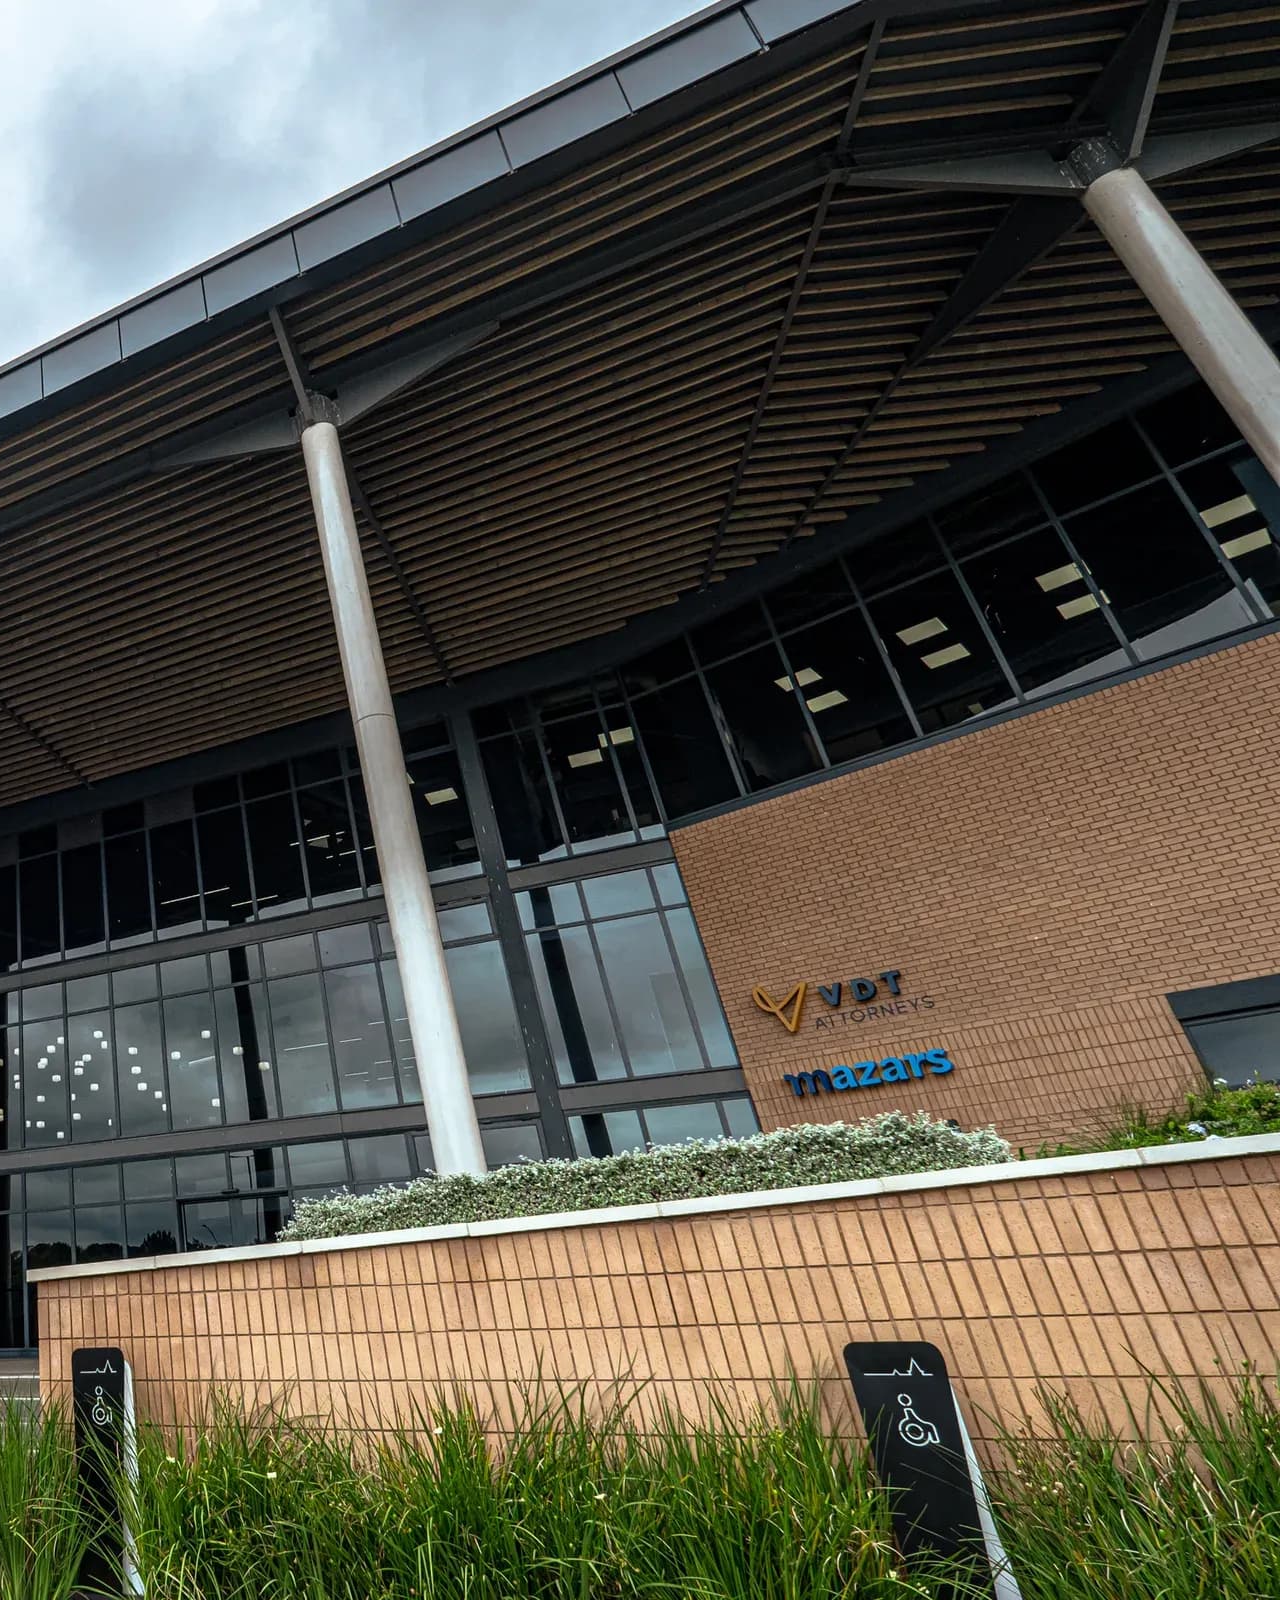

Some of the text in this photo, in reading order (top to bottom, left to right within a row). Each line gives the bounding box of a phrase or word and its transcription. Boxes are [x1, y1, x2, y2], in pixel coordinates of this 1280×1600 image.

[817, 969, 901, 1007] VDT
[816, 996, 935, 1029] ATTORNEYS
[783, 1047, 955, 1097] mazars
